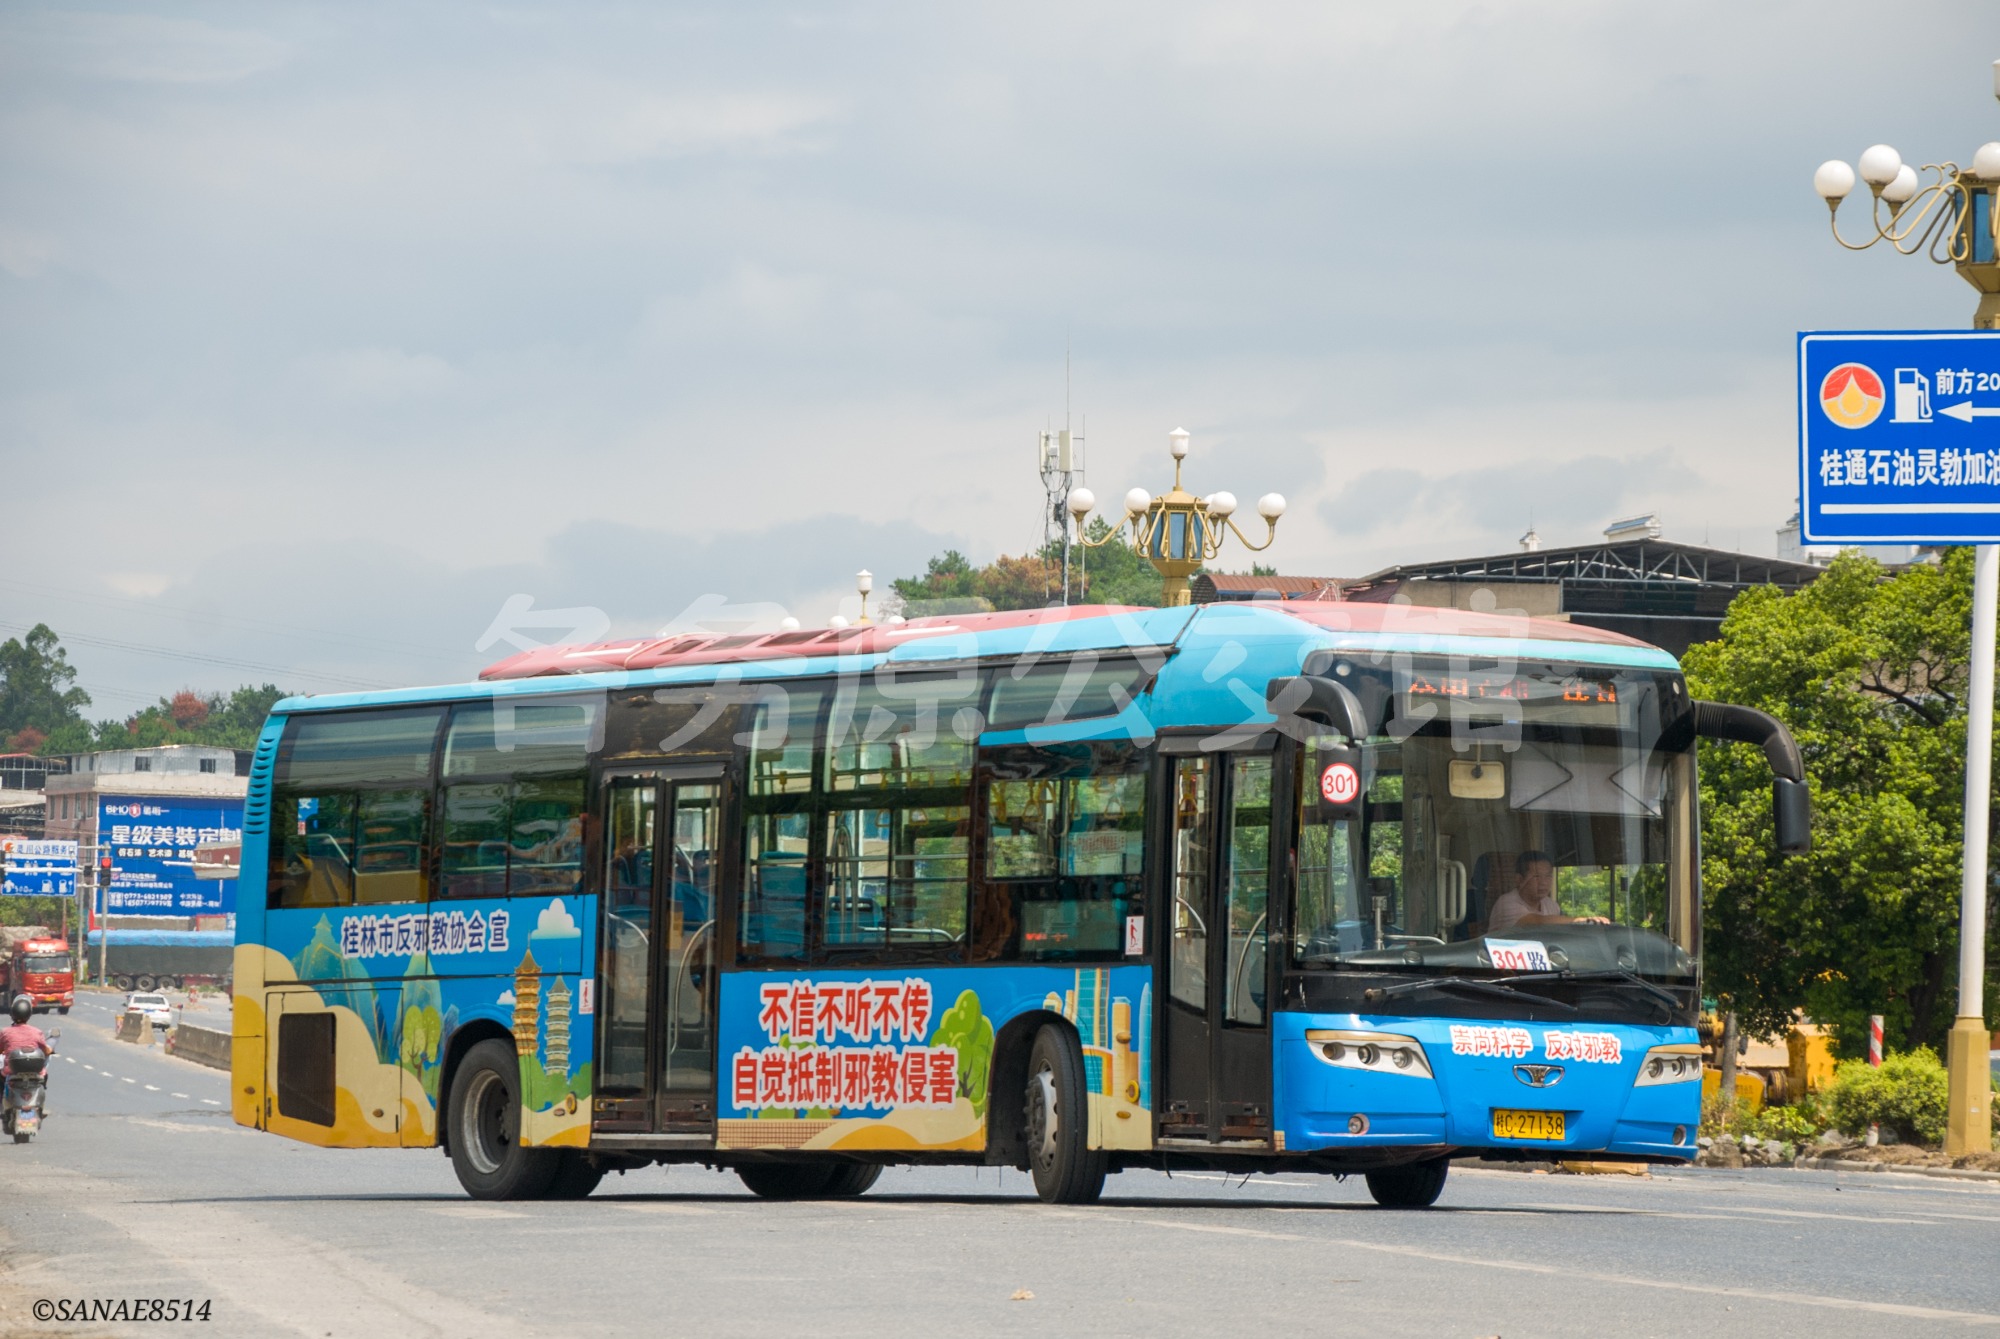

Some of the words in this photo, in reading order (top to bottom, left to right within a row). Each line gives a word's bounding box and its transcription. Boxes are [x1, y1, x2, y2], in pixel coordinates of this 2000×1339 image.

[1324, 773, 1354, 795] 301
[761, 983, 930, 1038] 不信不听不传
[1451, 1026, 1532, 1057] 崇尚科学
[1545, 1032, 1622, 1062] 反对邪教
[734, 1049, 957, 1105] 自觉抵制邪教侵害
